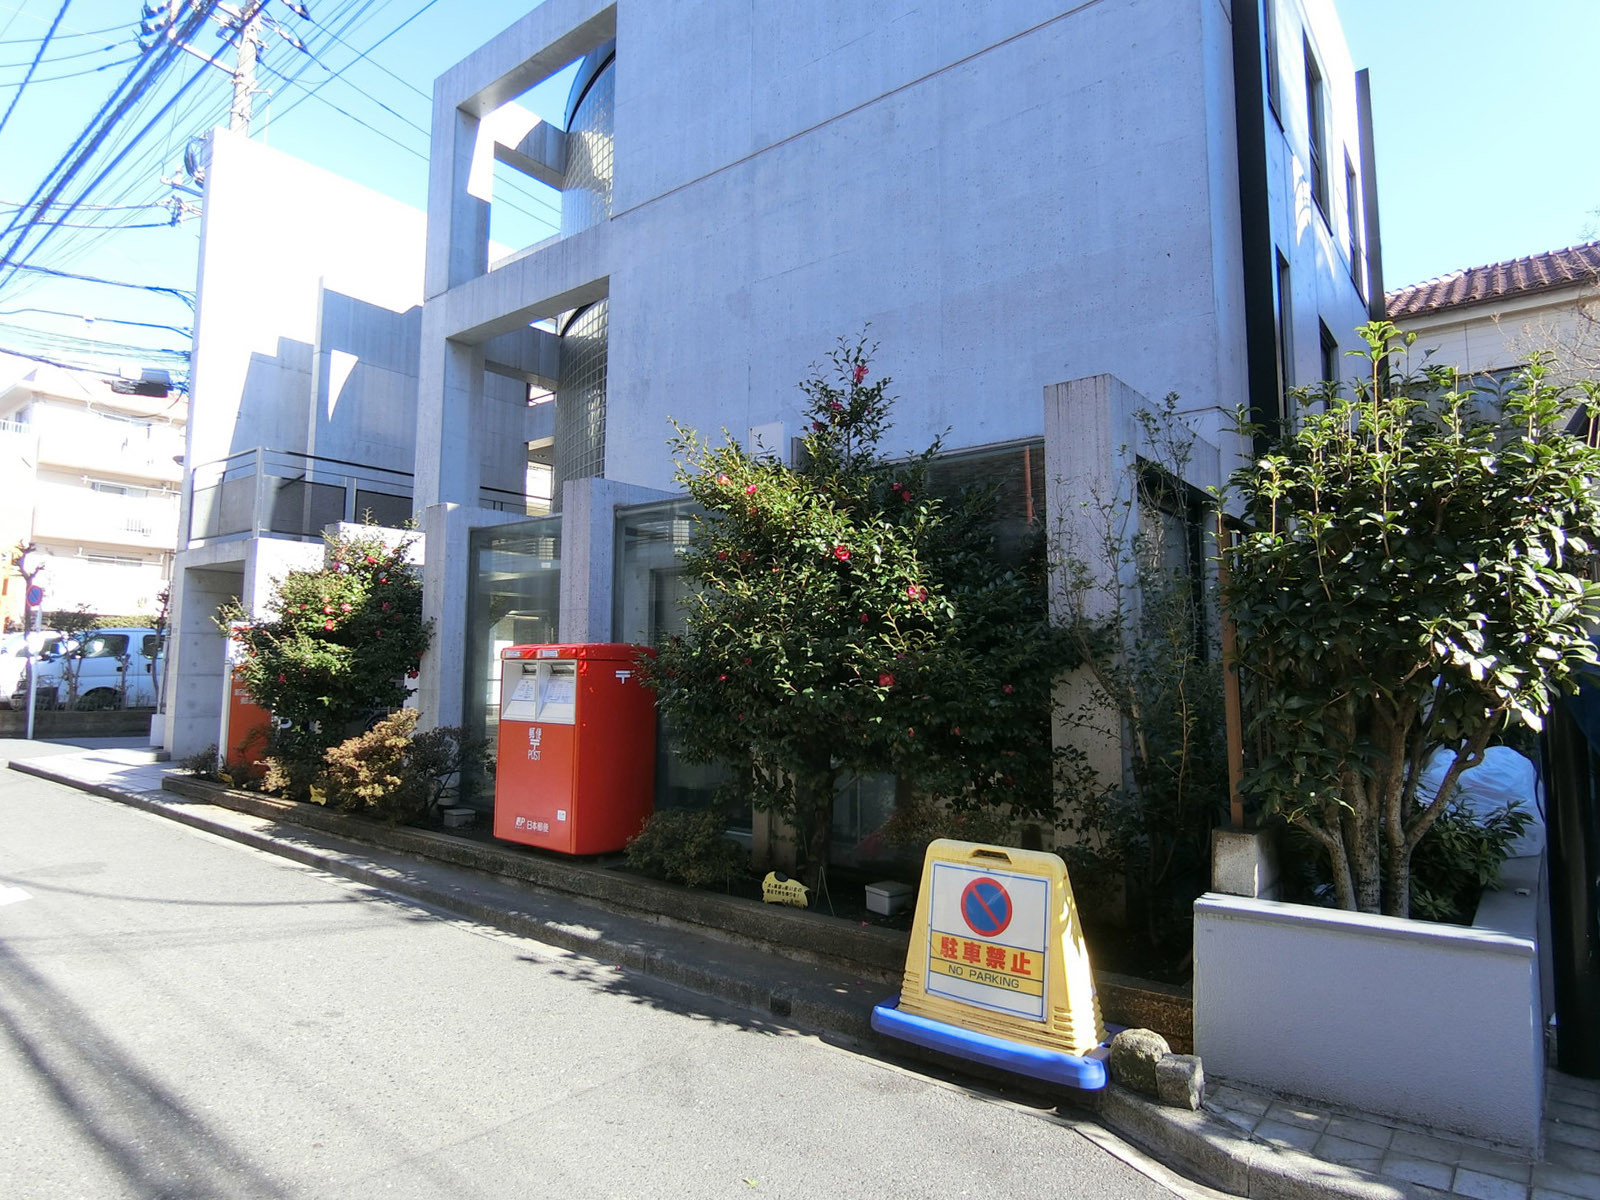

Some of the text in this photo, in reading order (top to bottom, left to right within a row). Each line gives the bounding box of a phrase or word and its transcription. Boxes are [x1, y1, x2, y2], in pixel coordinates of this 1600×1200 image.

[528, 727, 542, 740] 郵便
[528, 750, 541, 761] POST
[527, 820, 549, 832] 日本郵便
[940, 936, 1031, 975] 駐車禁止
[948, 965, 1020, 988] NO PARKING
